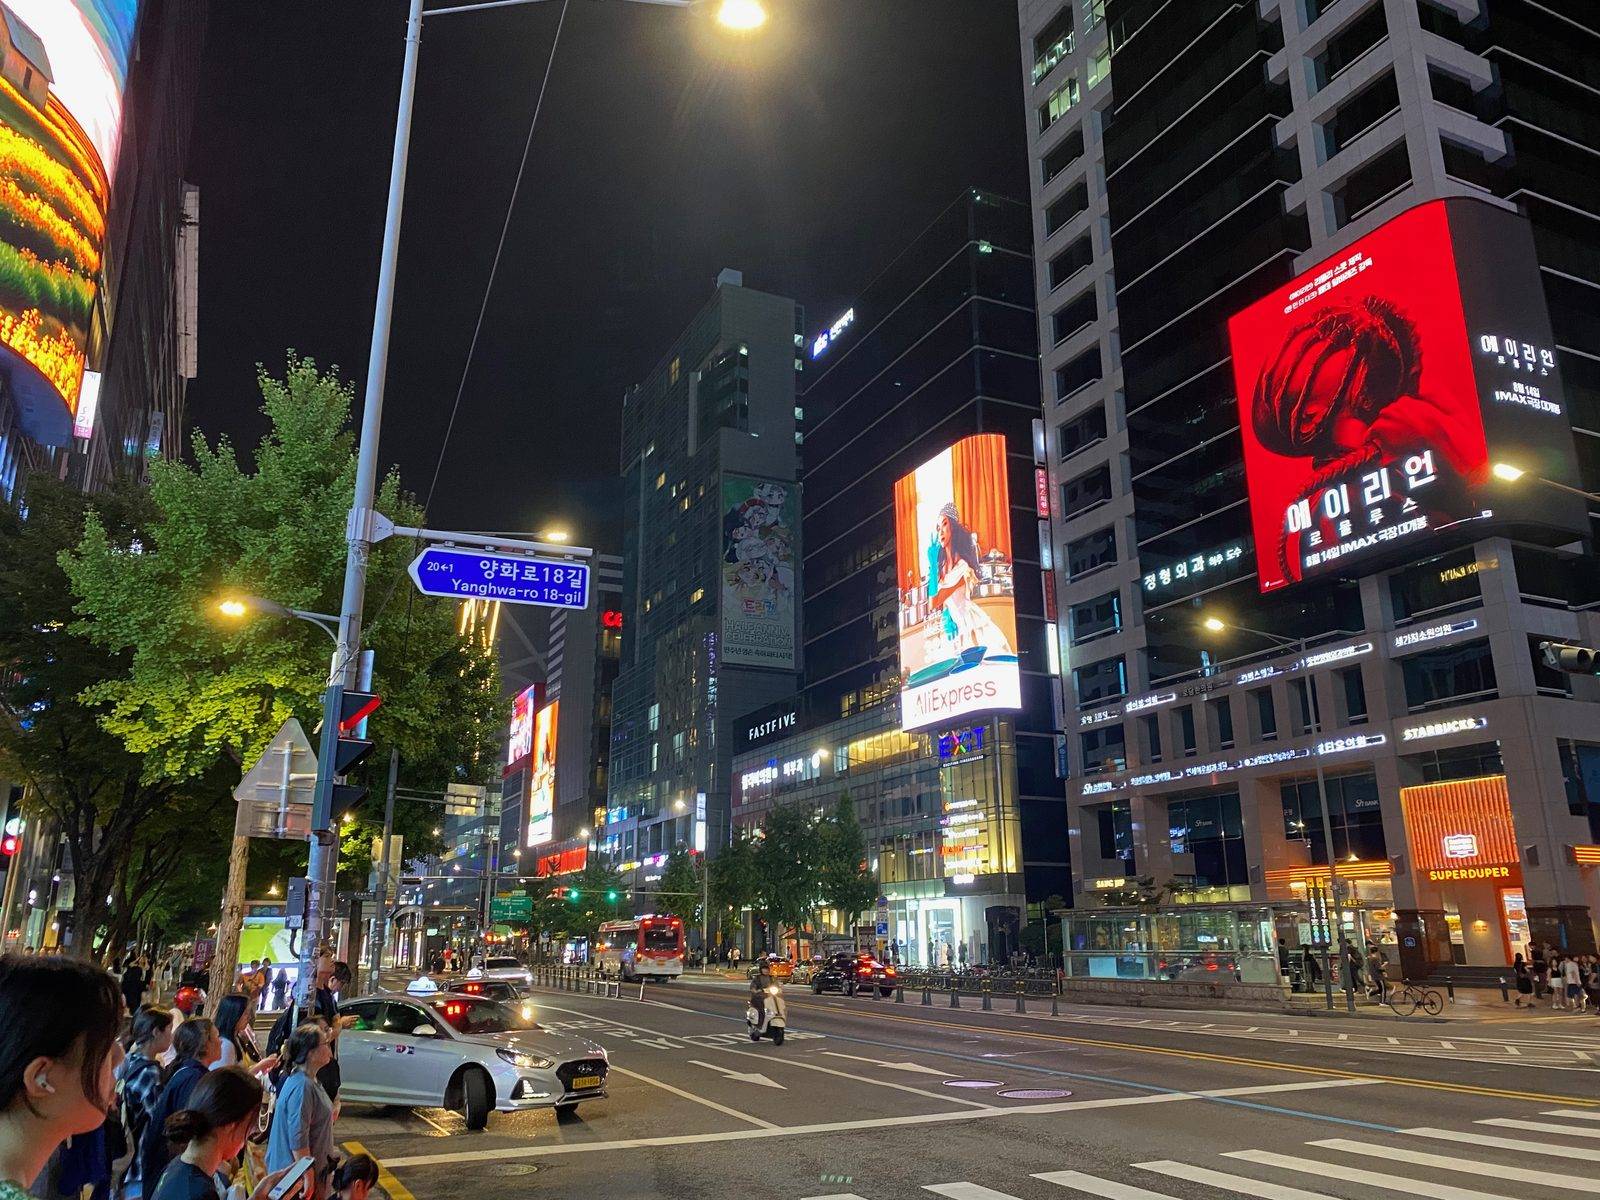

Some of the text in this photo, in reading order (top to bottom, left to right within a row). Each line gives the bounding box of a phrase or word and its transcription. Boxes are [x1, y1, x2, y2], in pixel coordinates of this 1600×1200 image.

[1481, 335, 1555, 368] 에이리언
[1495, 391, 1527, 404] IMAX
[1287, 450, 1437, 533] 에이리언
[1310, 497, 1418, 546] 로물루스
[1305, 515, 1428, 567] 8월 14일 IMAX 극장 대개봉
[427, 561, 440, 572] 20
[479, 559, 583, 589] 양화로18길
[1143, 555, 1205, 590] 정형외과
[1226, 546, 1242, 561] 도수
[452, 578, 582, 604] Yanghwa-ro 18-gil
[914, 680, 998, 719] AliExpress
[749, 712, 796, 740] FASTFIVE
[1403, 718, 1476, 740] STARBUCKS
[1430, 866, 1510, 881] SUPERDUPER
